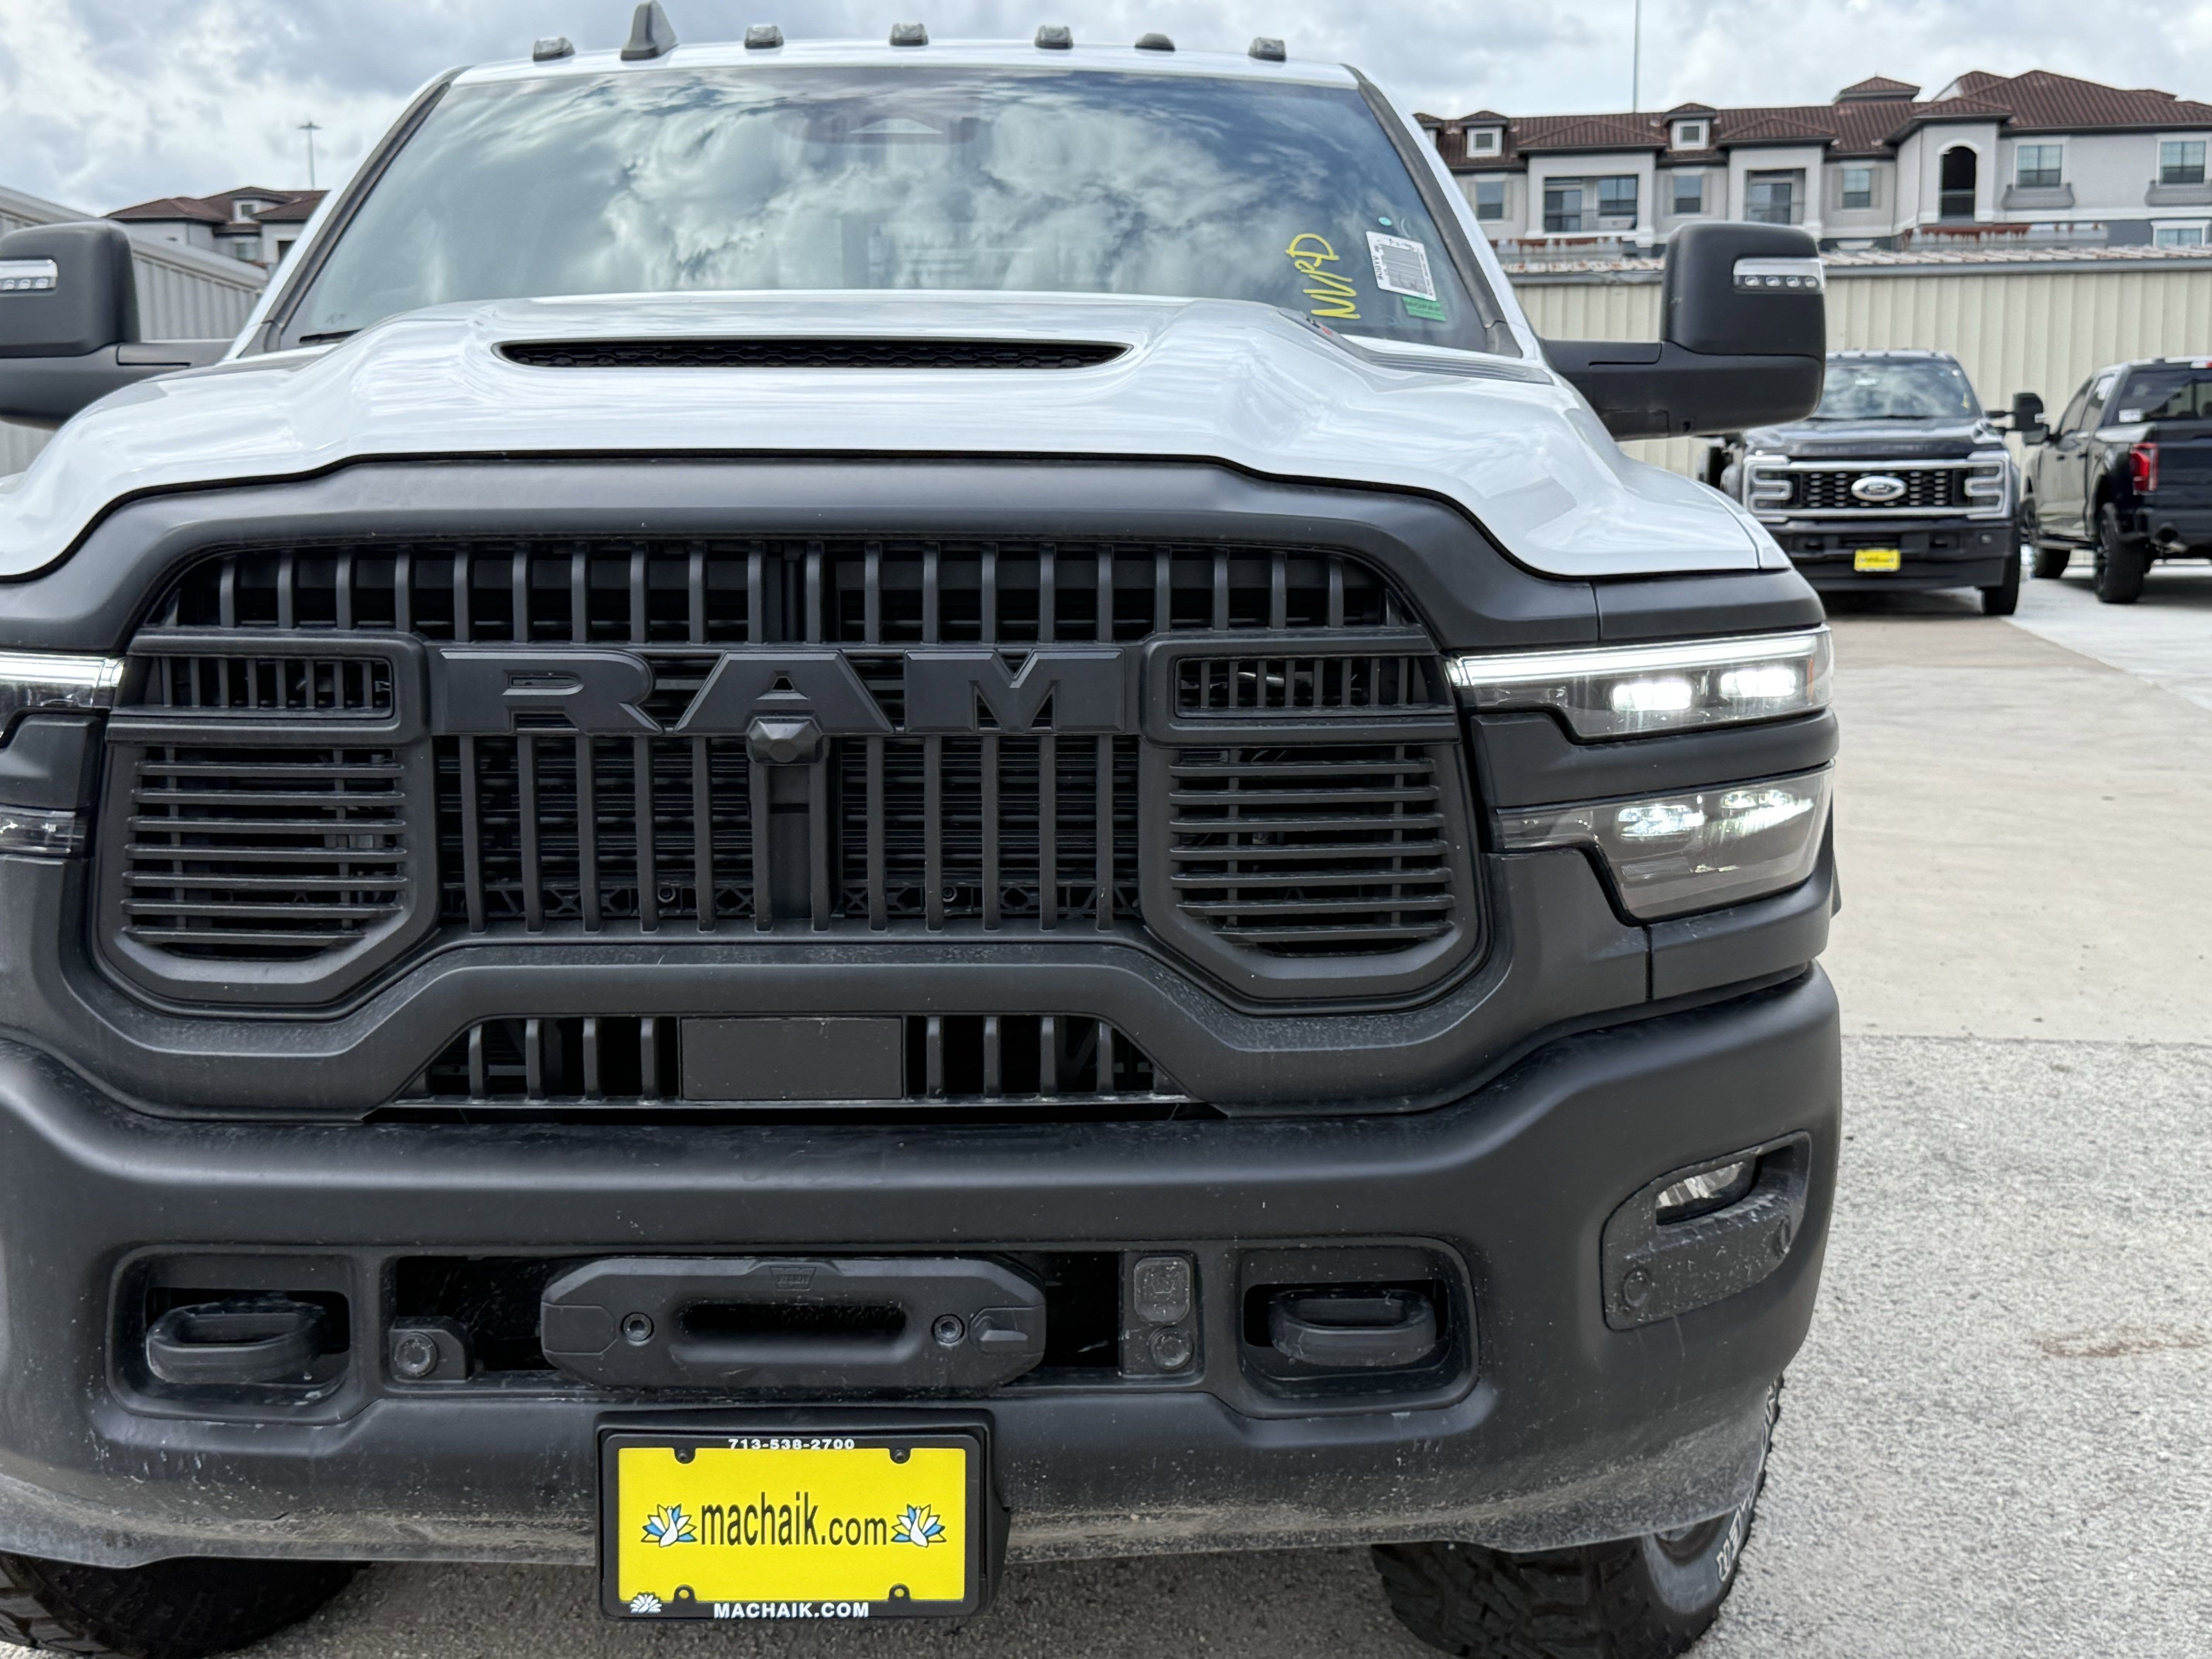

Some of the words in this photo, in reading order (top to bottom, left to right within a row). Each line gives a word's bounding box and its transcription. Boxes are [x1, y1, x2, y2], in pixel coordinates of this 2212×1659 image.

[440, 649, 1125, 734] RAM
[728, 1438, 855, 1450] 713-538-2700
[701, 1491, 887, 1546] machaik.com
[713, 1602, 869, 1619] MACHAIK.COM
